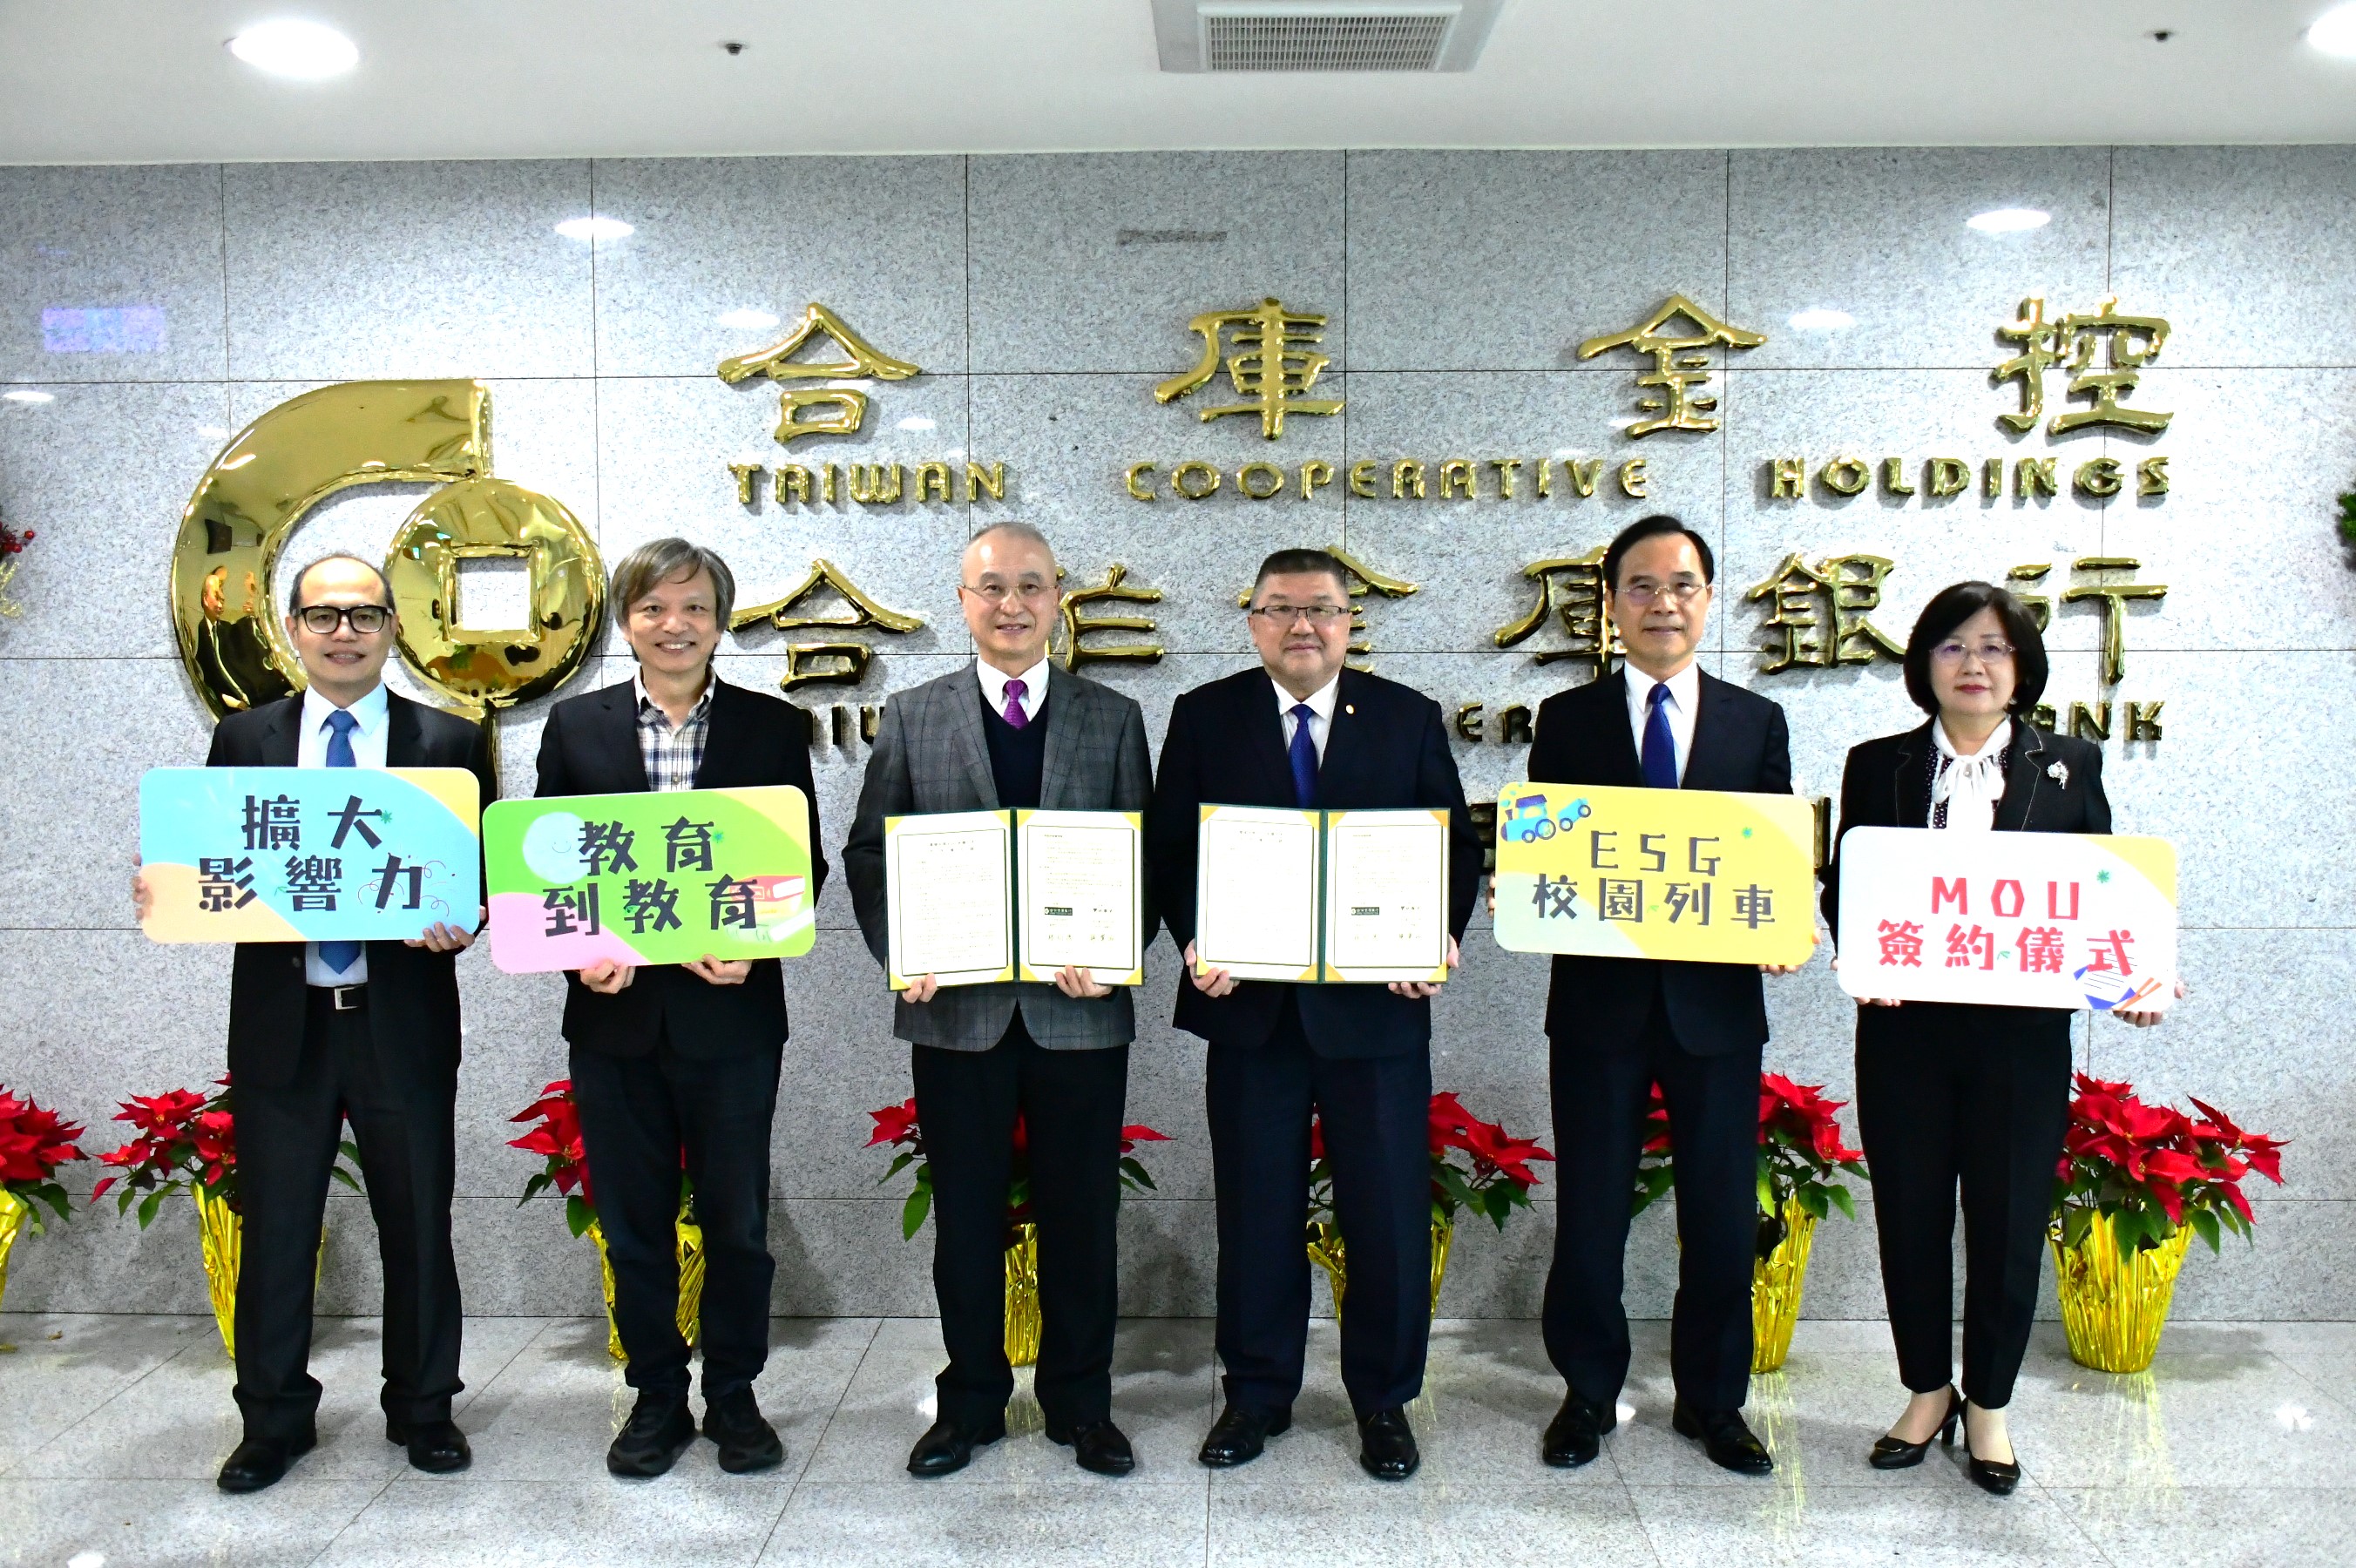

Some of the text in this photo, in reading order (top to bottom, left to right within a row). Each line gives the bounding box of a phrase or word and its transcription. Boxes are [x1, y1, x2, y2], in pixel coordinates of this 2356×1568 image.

[718, 293, 2174, 443] 合庫金控
[728, 456, 2170, 504] TAIWAN COOPERATIVE HOLDINGS
[2023, 700, 2164, 740] ANK
[240, 794, 383, 850] 擴大
[578, 816, 714, 876] 教育
[1590, 830, 1721, 876] ESG
[198, 855, 423, 912] 影響力
[543, 875, 758, 936] 到教育
[1531, 873, 1776, 929] 校園列車
[1931, 876, 2081, 921] MOU
[1877, 919, 2136, 976] 簽約儀式
